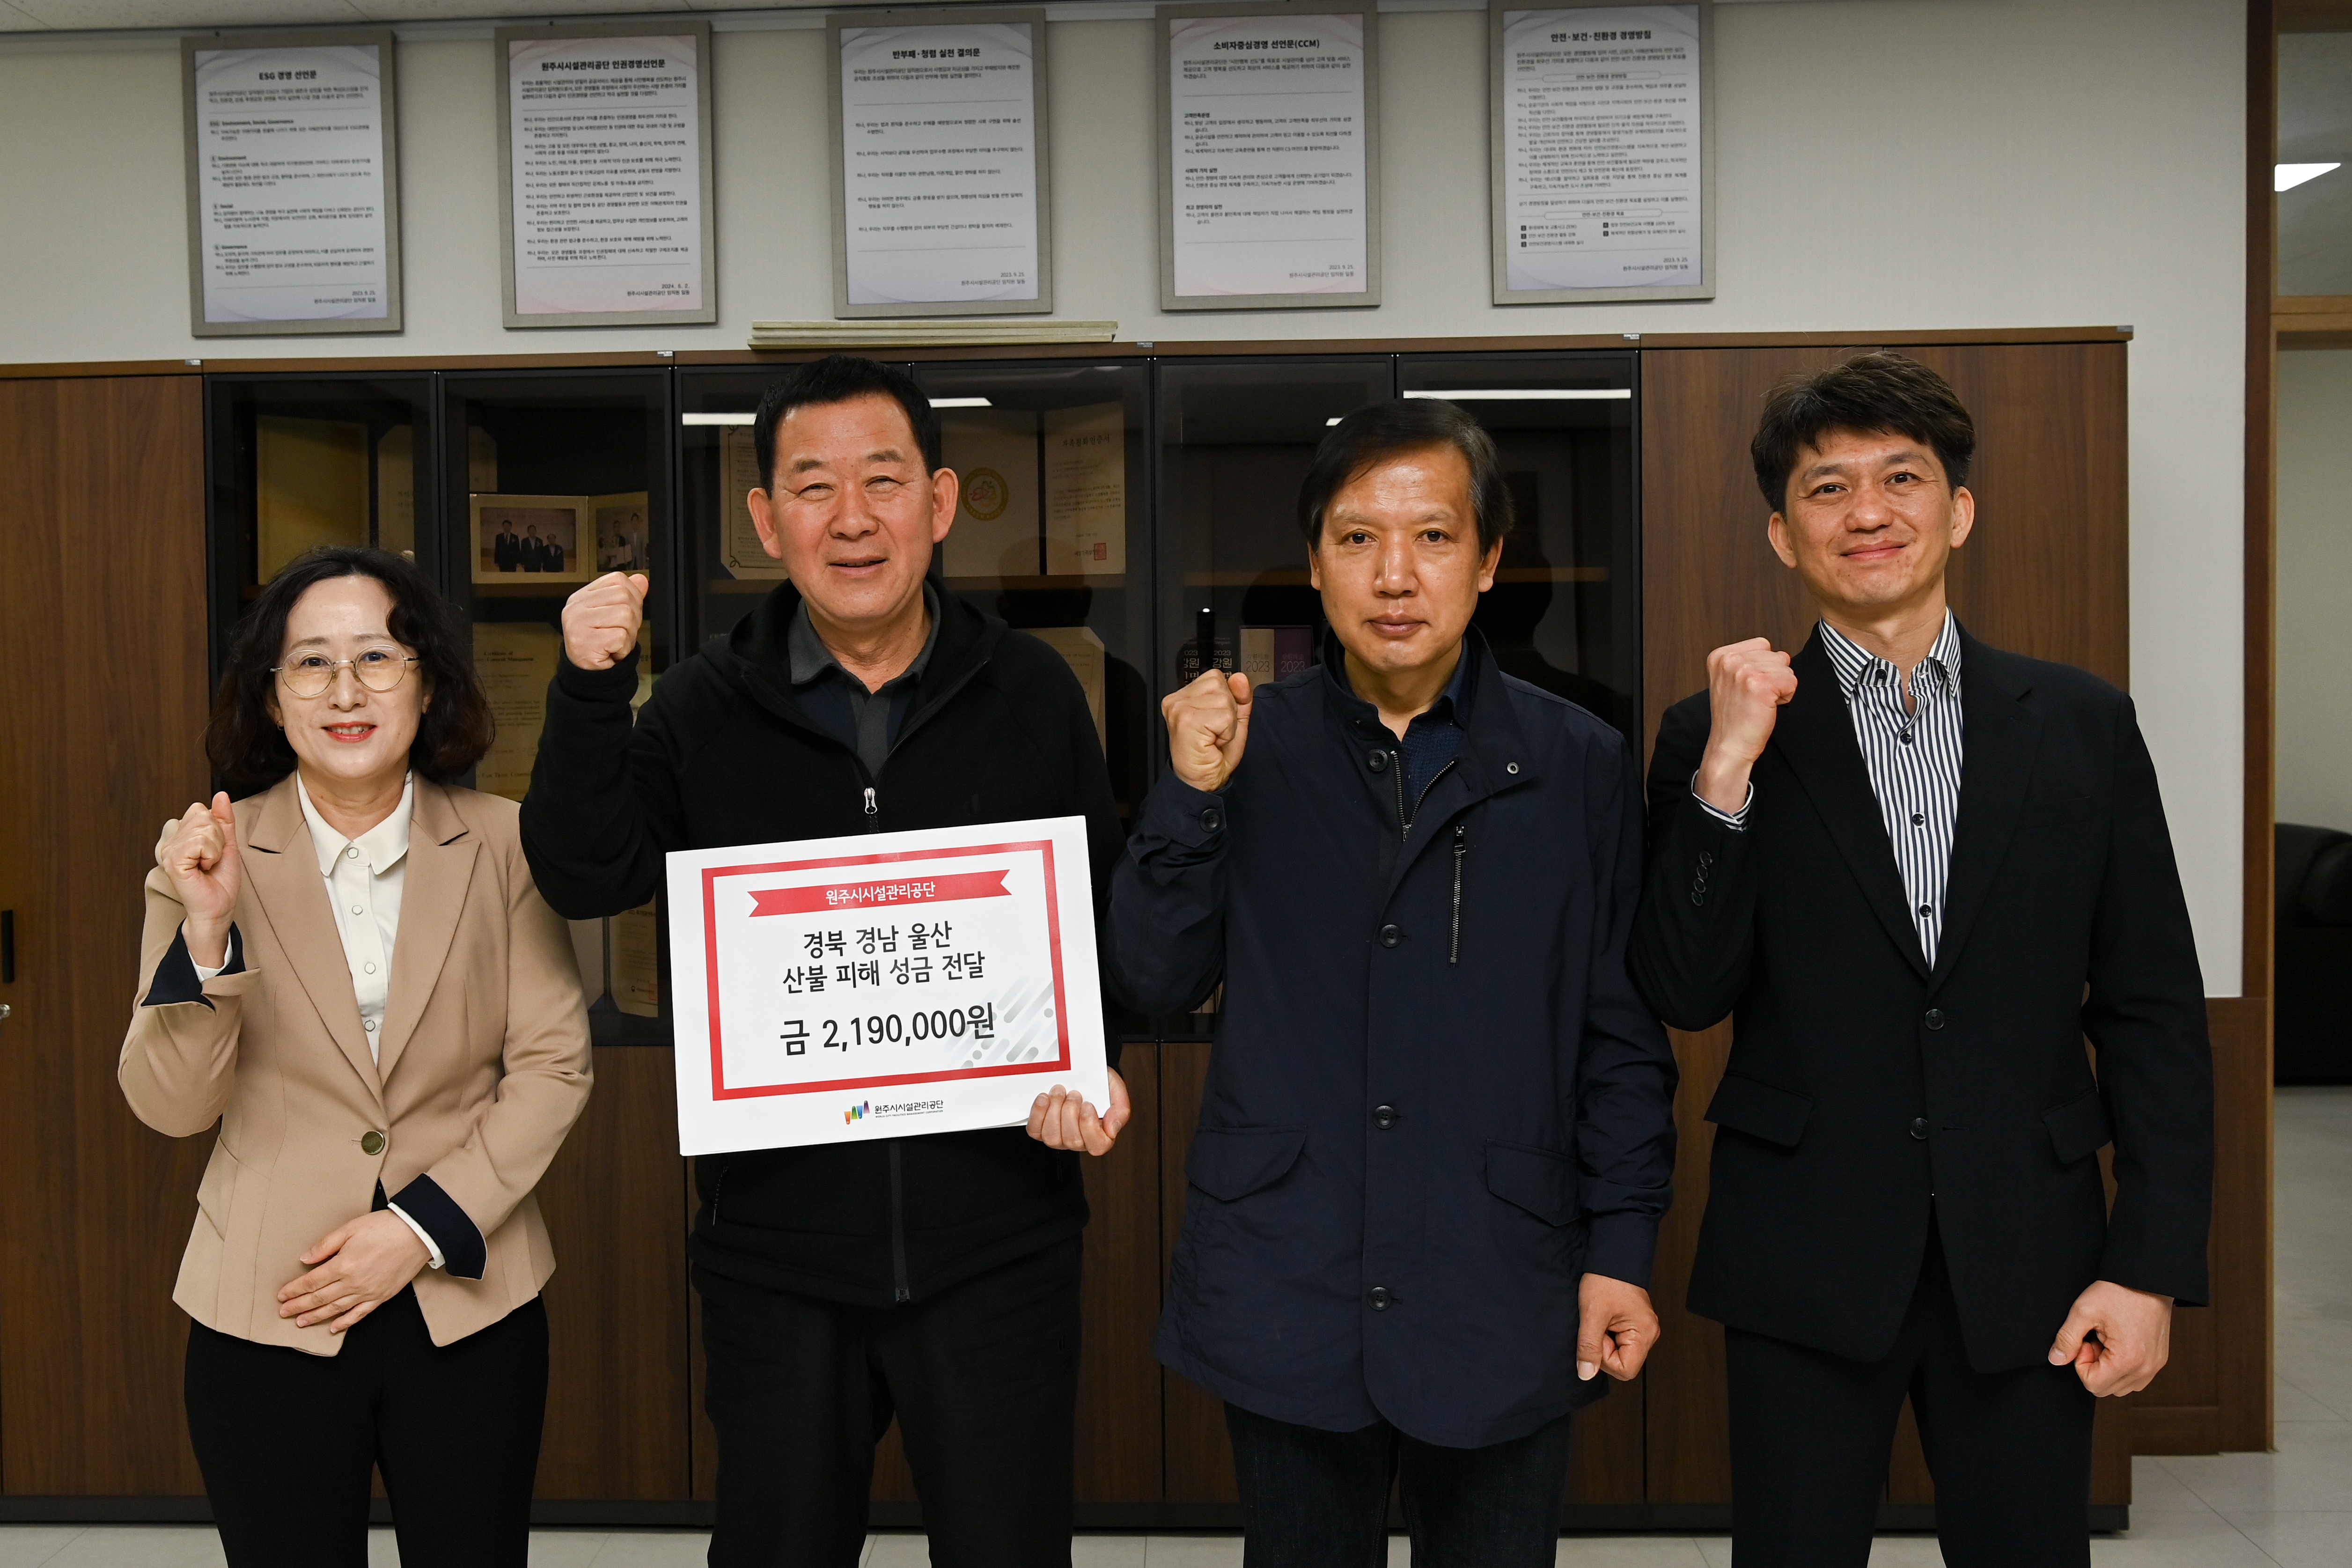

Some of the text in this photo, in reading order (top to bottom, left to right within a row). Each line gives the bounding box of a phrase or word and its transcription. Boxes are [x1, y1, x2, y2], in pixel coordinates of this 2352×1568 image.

[1213, 39, 1319, 50] 소비자중심경영 선언문(CCM)
[892, 48, 980, 59] 반부패·청렴 실천 결의문
[541, 59, 665, 71] 원주시시설관리공단 인권경영선언문
[258, 70, 316, 80] ESG 경영 선언문
[1213, 658, 1232, 668] 강원
[1246, 661, 1270, 672] 2023
[1281, 661, 1305, 672] 2023
[825, 881, 936, 905] 원주시시설관리공단
[803, 920, 952, 959] 경북 경남 울산
[782, 951, 985, 994] 산불 피해 성금 전달
[780, 1002, 995, 1056] 금 2,190,000원
[875, 1100, 944, 1114] 원주시시설관리공단
